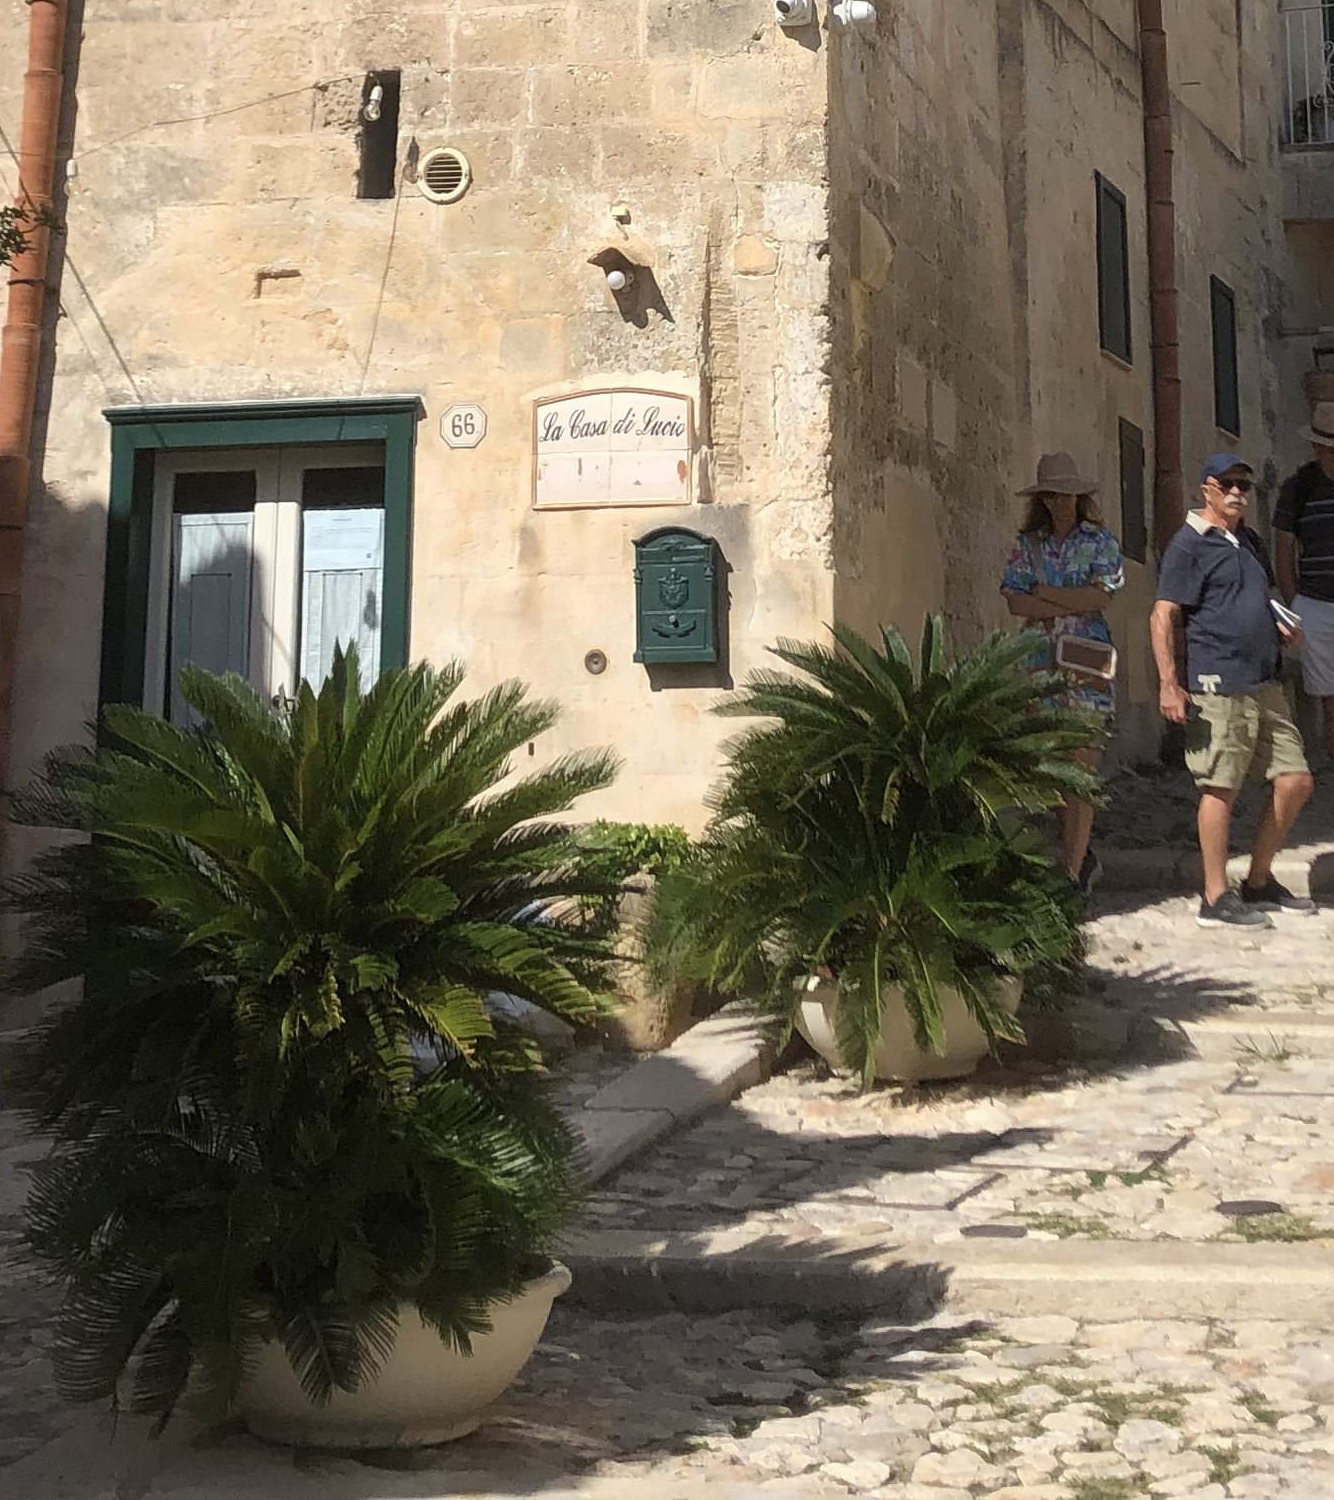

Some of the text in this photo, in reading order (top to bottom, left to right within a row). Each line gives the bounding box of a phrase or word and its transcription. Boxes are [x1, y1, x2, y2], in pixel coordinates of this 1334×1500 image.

[452, 412, 475, 438] 66
[539, 406, 686, 442] La Casa di Lucio
